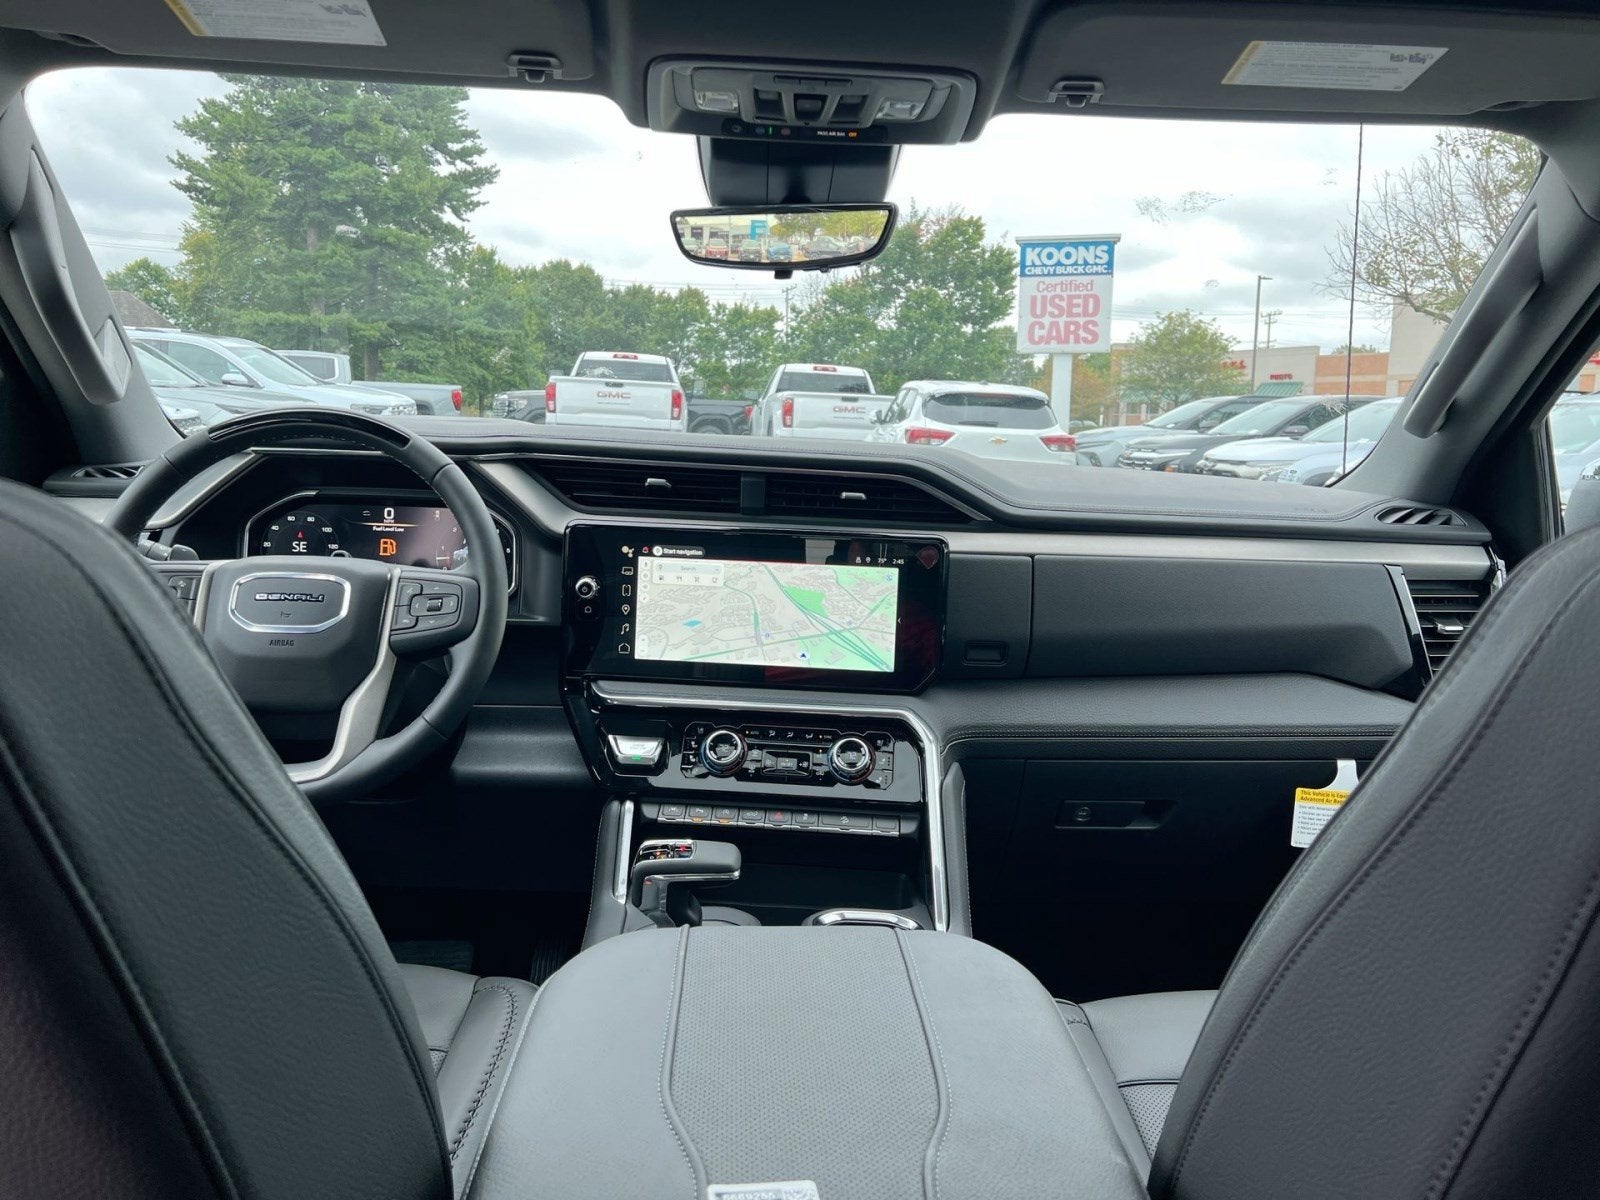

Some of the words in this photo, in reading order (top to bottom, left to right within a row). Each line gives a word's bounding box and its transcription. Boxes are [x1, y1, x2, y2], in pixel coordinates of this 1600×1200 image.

[1025, 245, 1110, 266] KOONS
[1025, 266, 1055, 275] CHEVY
[1056, 266, 1085, 274] BUICK
[1037, 280, 1094, 292] Certified
[1030, 294, 1101, 319] USED
[1028, 320, 1099, 345] CARS
[596, 391, 631, 399] GMC
[832, 405, 866, 414] GMC
[291, 541, 308, 552] SE
[676, 549, 703, 557] navigation
[254, 593, 325, 602] DENALI
